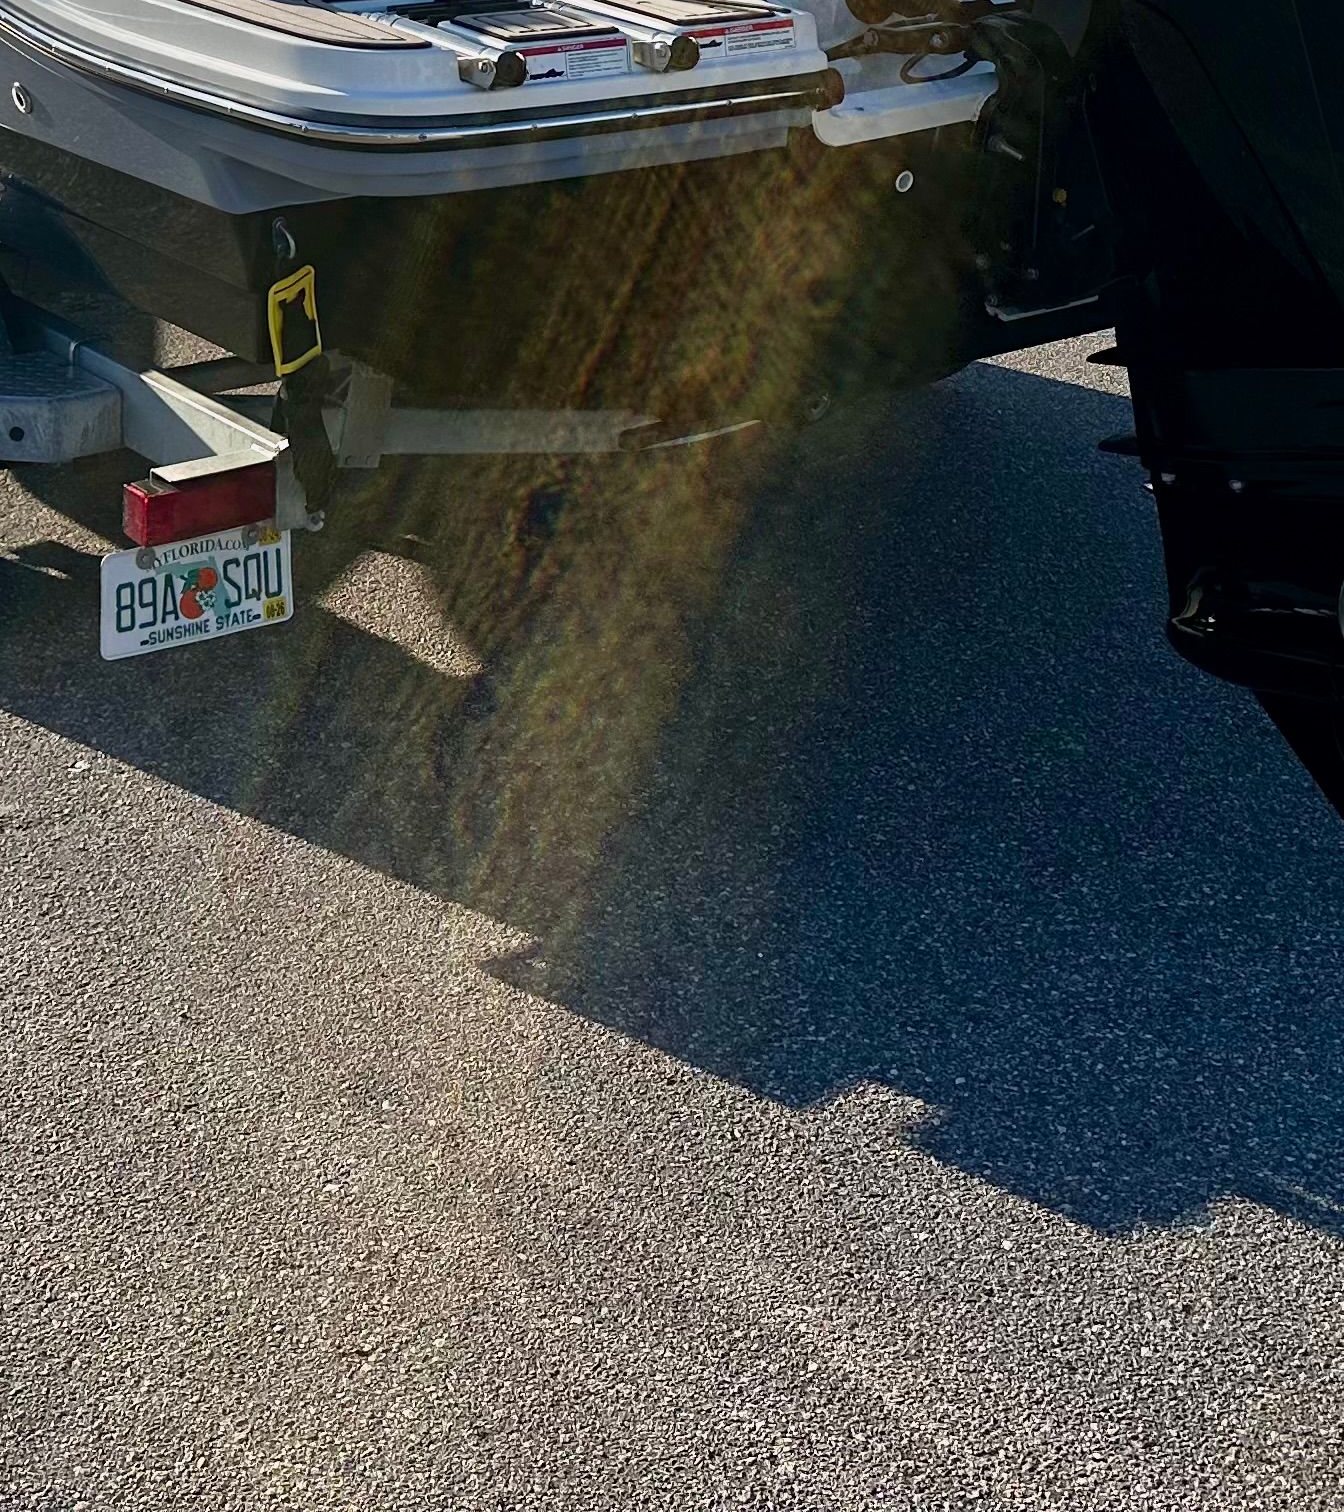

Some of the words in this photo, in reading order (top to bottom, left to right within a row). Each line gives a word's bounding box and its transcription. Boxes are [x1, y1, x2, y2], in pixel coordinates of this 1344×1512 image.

[115, 573, 180, 633] 89A
[222, 548, 283, 609] SQU
[148, 619, 210, 646] SUNSHINE
[215, 609, 253, 631] STATE
